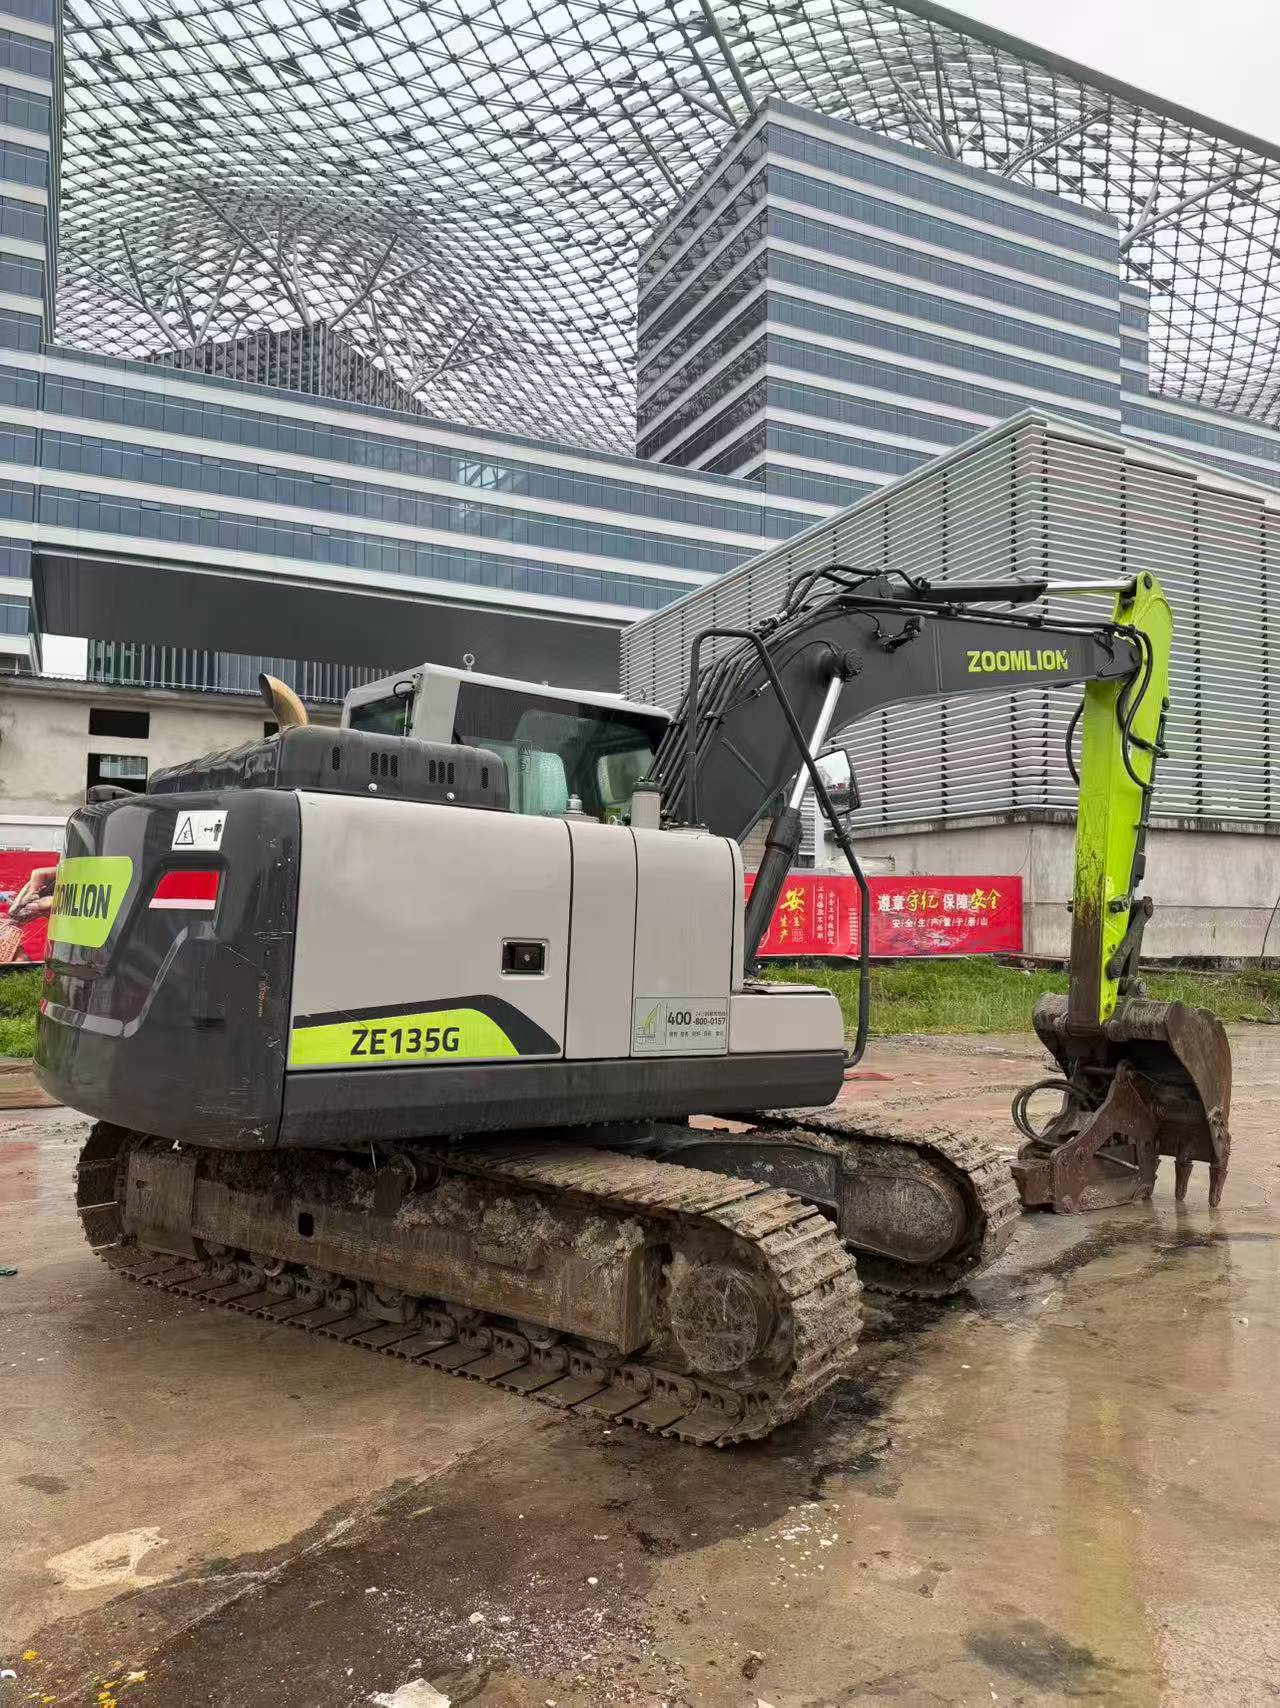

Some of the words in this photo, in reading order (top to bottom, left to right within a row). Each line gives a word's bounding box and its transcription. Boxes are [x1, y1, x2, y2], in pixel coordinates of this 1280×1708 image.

[966, 649, 1069, 672] ZOOMLION
[52, 883, 112, 919] OOMLION
[350, 1027, 460, 1056] ZE135G
